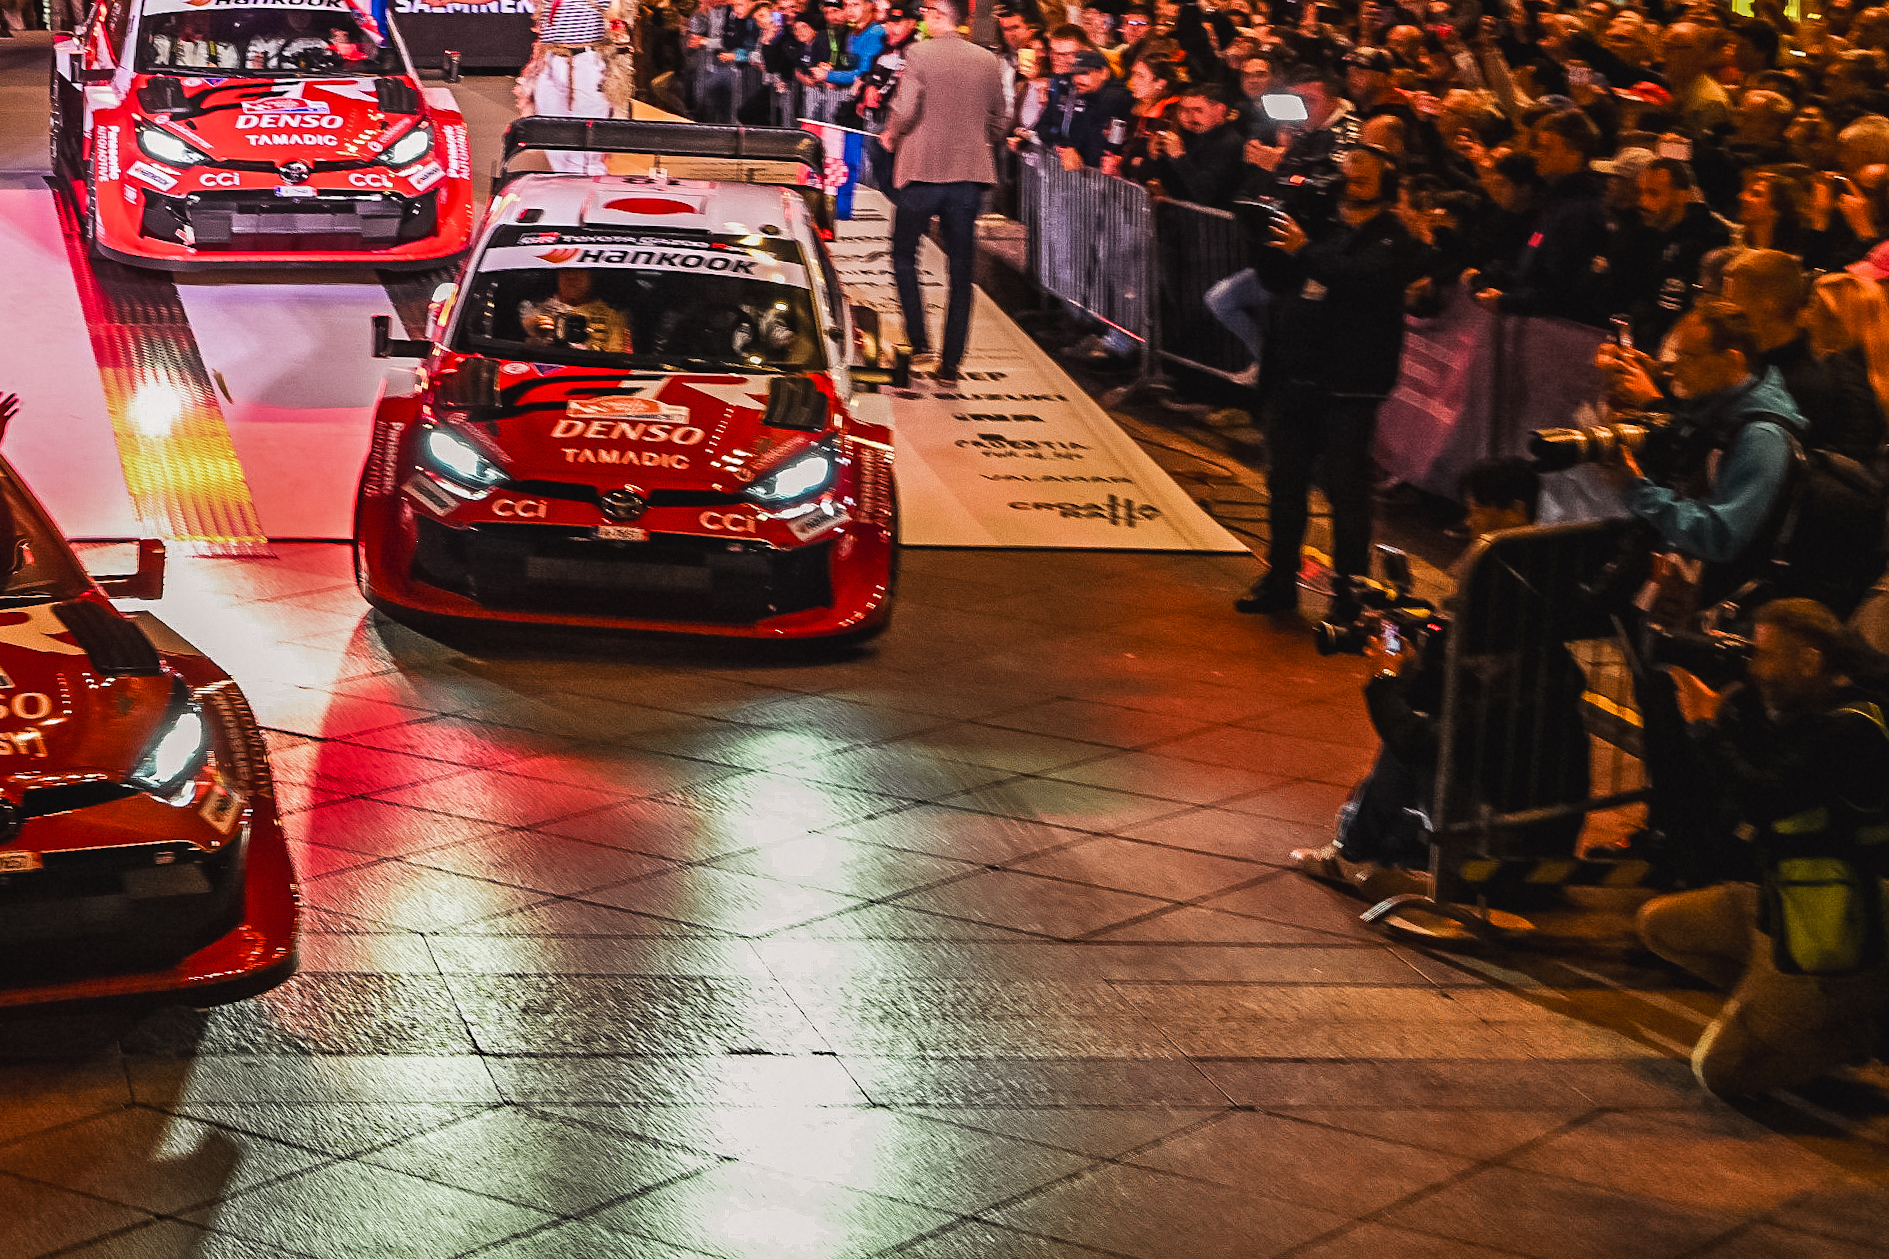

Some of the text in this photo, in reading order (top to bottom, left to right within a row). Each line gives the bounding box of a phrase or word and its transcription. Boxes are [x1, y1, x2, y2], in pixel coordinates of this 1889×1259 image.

[236, 115, 344, 129] DENSO
[245, 134, 338, 147] TAMADIC
[551, 419, 705, 446] DENSO
[562, 447, 689, 470] TAMADIC
